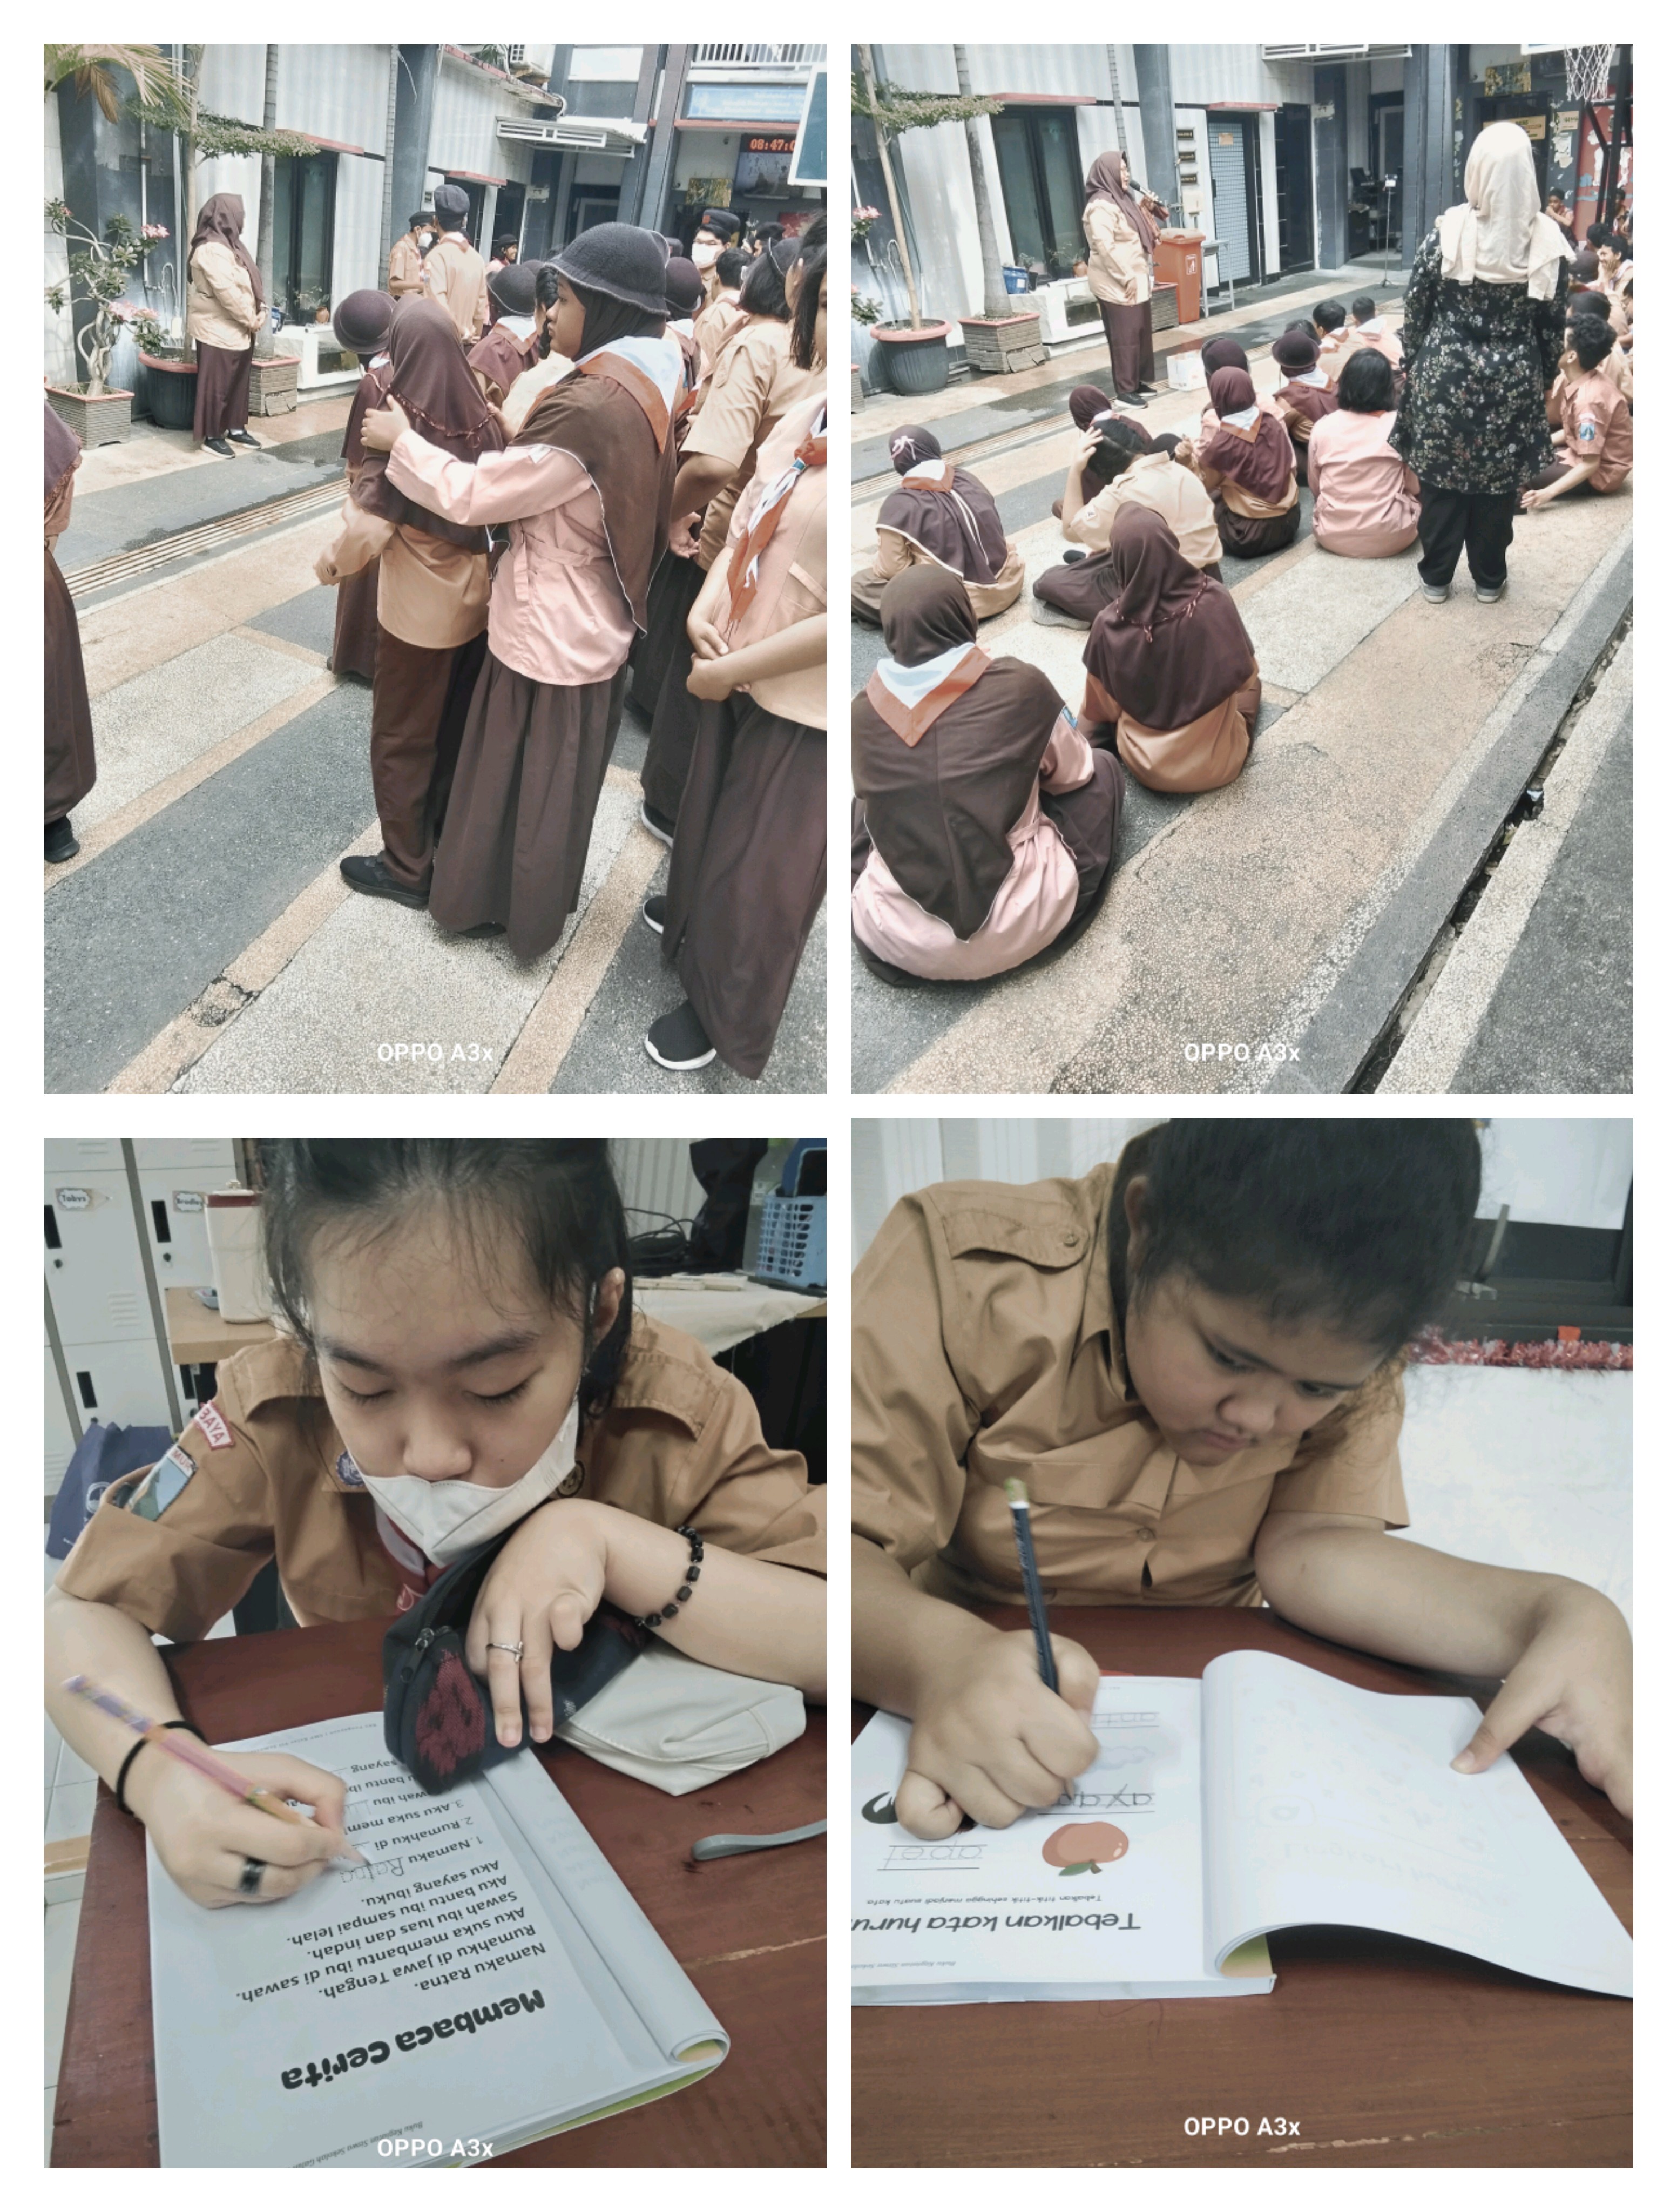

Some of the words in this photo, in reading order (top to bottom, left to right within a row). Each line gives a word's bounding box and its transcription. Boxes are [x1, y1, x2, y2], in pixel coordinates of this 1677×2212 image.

[350, 1759, 398, 1773] sayang
[365, 1776, 405, 1789] bantu
[373, 1796, 396, 1806] ibu
[387, 1810, 421, 1825] suka
[374, 1839, 388, 1851] di
[469, 1859, 499, 1878] Aku
[413, 1870, 467, 1894] sayang
[477, 1874, 508, 1893] Aku
[361, 1887, 411, 1907] ibuku.
[429, 1886, 475, 1907] bantu
[465, 1890, 518, 1914] Sawah
[924, 1897, 963, 1905] menjadi
[399, 1900, 425, 1917] ibu
[436, 1908, 463, 1925] ibu
[493, 1907, 525, 1925] Aku
[336, 1908, 395, 1934] sampai
[399, 1917, 433, 1936] luas
[451, 1918, 491, 1939] suka
[851, 1918, 921, 1934] huru
[927, 1916, 998, 1933] kata
[1005, 1912, 1141, 1931] Tebalkan
[287, 1927, 333, 1947] lelah.
[364, 1928, 396, 1945] dan
[456, 1924, 536, 1958] Rumahku
[307, 1937, 361, 1961] indah.
[356, 1933, 449, 1966] membantu
[474, 1943, 546, 1974] Namaku
[324, 1959, 353, 1977] ibu
[392, 1954, 432, 1978] Jawa
[436, 1952, 453, 1966] di
[303, 1968, 320, 1986] di
[319, 1973, 389, 1999] Tengah.
[414, 1967, 471, 1991] Ratna.
[236, 1974, 300, 2005] sawah.
[394, 1990, 545, 2052] Membaca
[281, 2041, 390, 2090] Cerita
